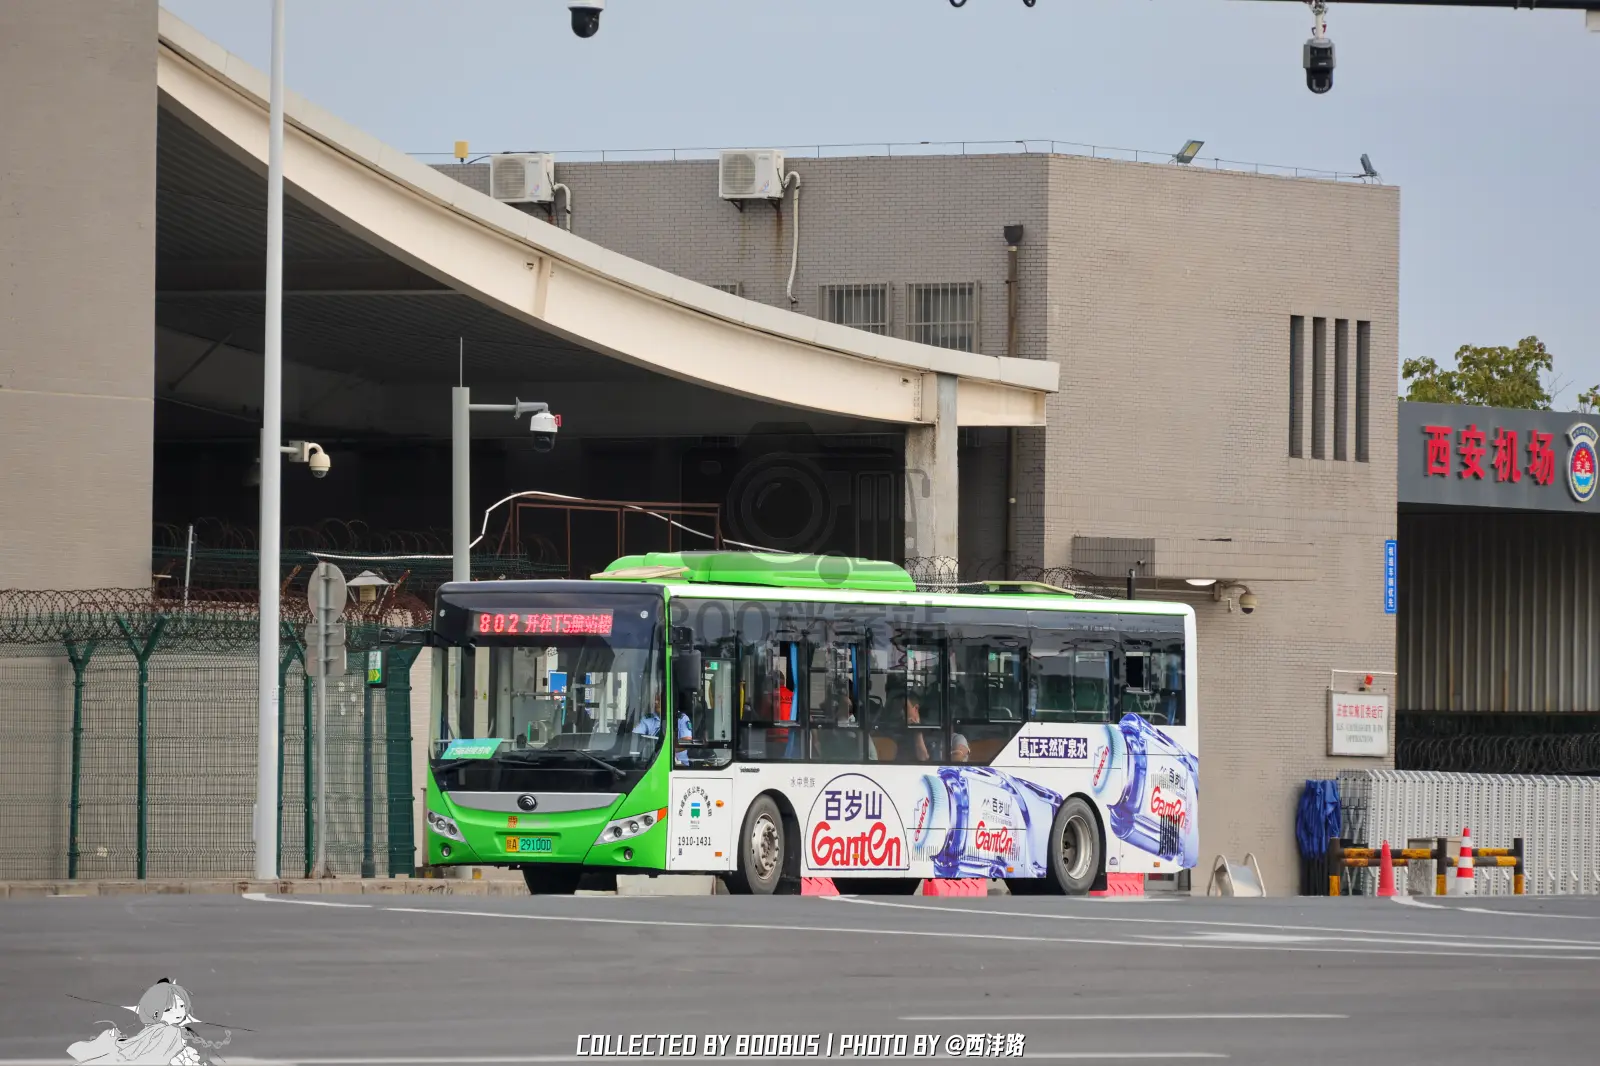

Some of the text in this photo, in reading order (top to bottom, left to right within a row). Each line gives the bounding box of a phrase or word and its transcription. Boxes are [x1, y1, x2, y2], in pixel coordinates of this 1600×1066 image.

[1423, 423, 1555, 485] 西安机场
[479, 612, 520, 634] 802
[1019, 737, 1087, 758] 真正天然矿泉水
[790, 776, 816, 788] 水中贵族
[824, 789, 883, 822] 百岁山
